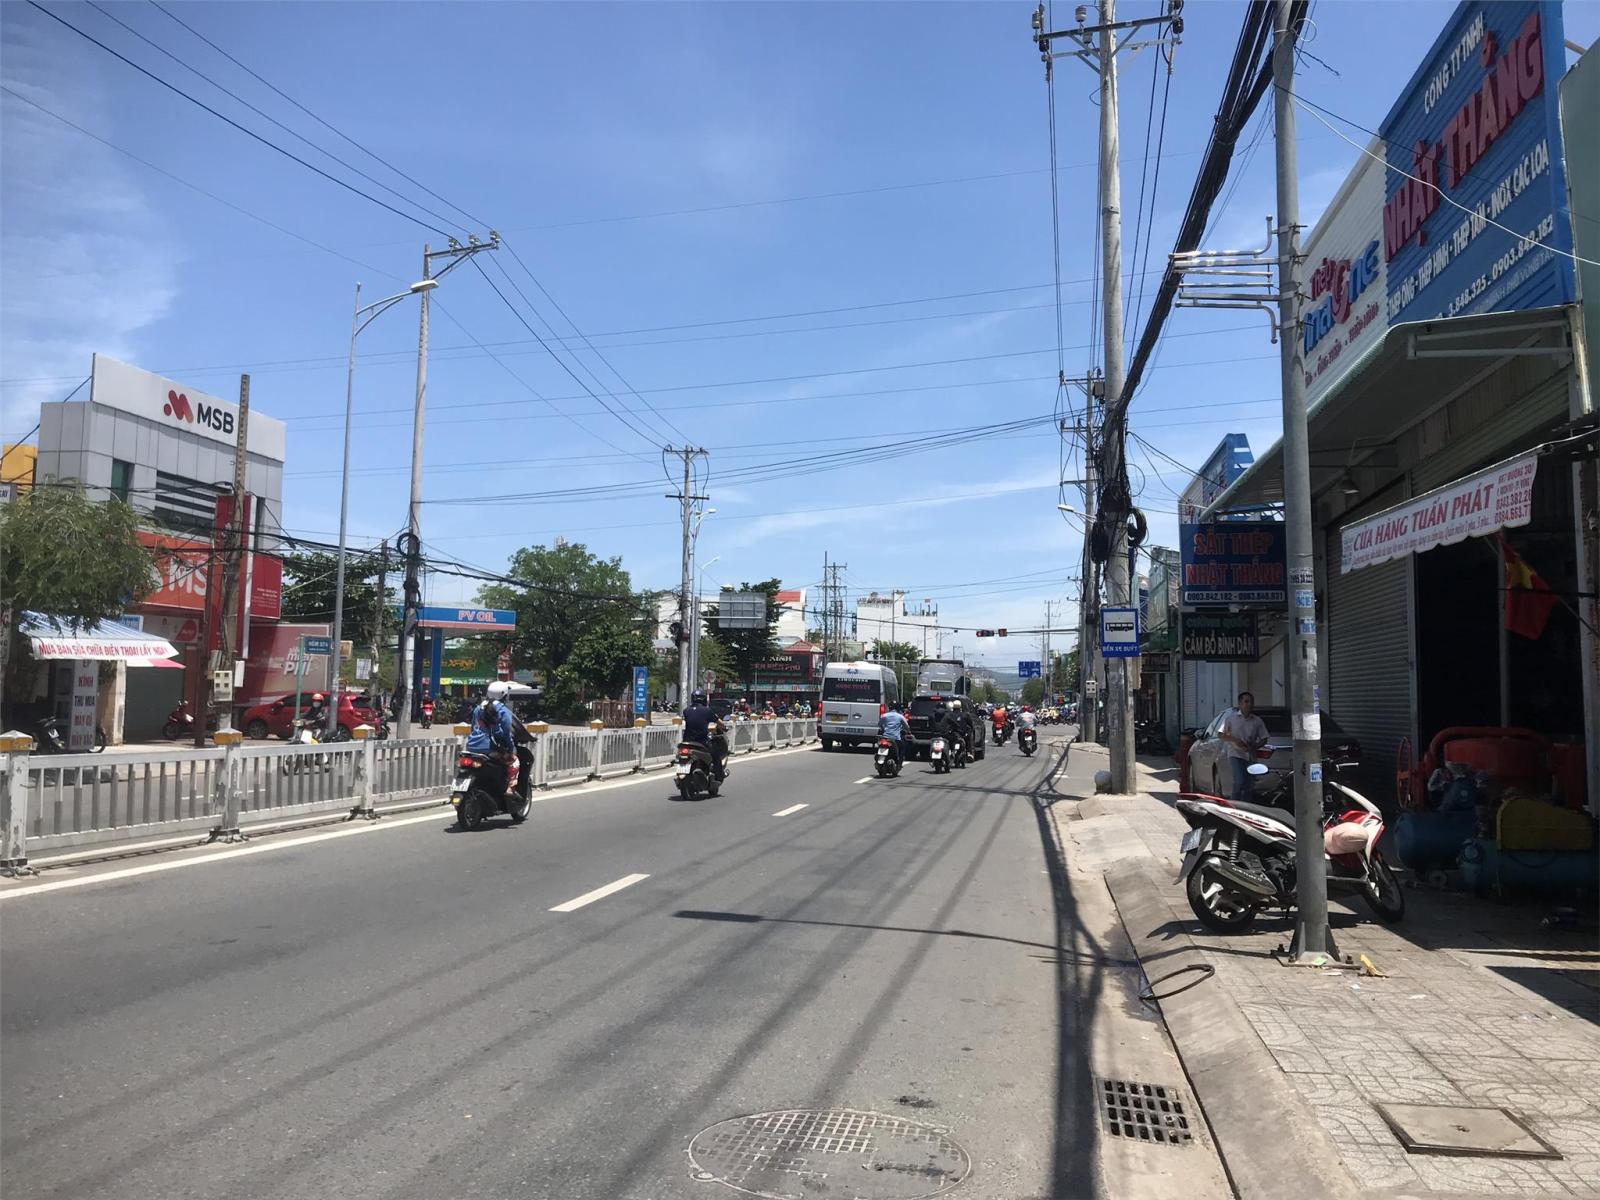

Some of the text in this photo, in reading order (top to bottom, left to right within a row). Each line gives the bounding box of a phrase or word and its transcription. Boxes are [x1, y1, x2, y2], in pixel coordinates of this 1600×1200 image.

[1424, 11, 1484, 115] CÔNG TY TNHH
[1491, 179, 1512, 219] INOX
[197, 403, 234, 434] MSB
[1354, 523, 1373, 551] CỬA
[1375, 513, 1408, 545] HÀNG
[1412, 497, 1448, 532] TUẤN
[1451, 482, 1494, 520] PHÁT
[458, 610, 497, 622] PV OIL
[39, 643, 56, 656] MUA
[1102, 644, 1114, 652] BẾN
[1219, 632, 1237, 656] BÌNH
